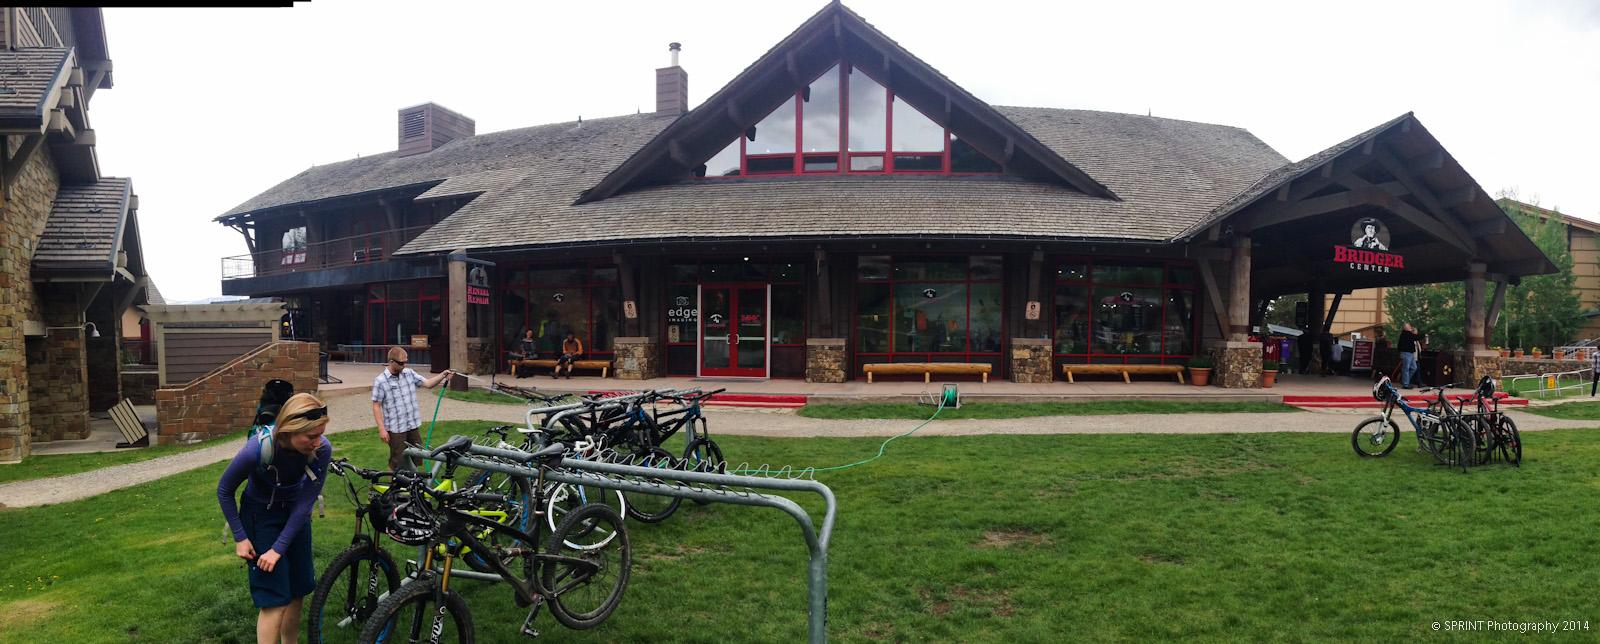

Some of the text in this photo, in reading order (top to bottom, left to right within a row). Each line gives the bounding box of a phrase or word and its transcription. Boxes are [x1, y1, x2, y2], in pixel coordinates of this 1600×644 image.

[1333, 245, 1405, 268] BRIDGER
[1350, 262, 1390, 273] CENTER
[668, 306, 698, 318] edge
